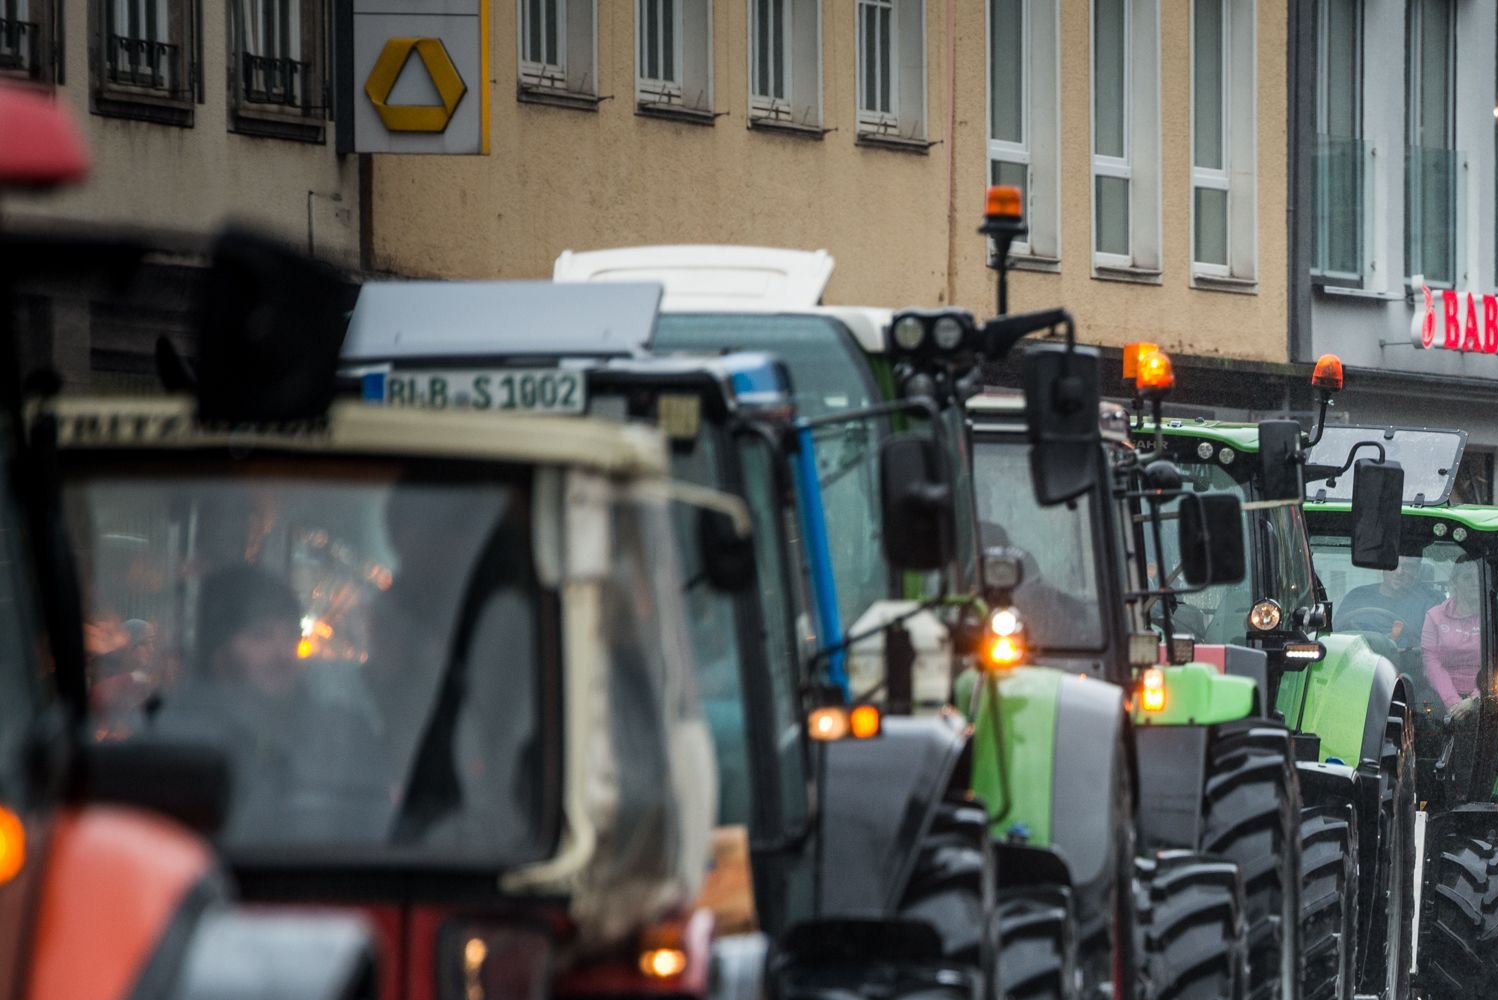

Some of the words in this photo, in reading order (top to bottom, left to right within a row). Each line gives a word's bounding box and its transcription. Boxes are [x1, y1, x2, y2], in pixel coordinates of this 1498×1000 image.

[472, 376, 491, 409] S
[500, 375, 576, 409] 1002
[1134, 440, 1169, 449] AHR
